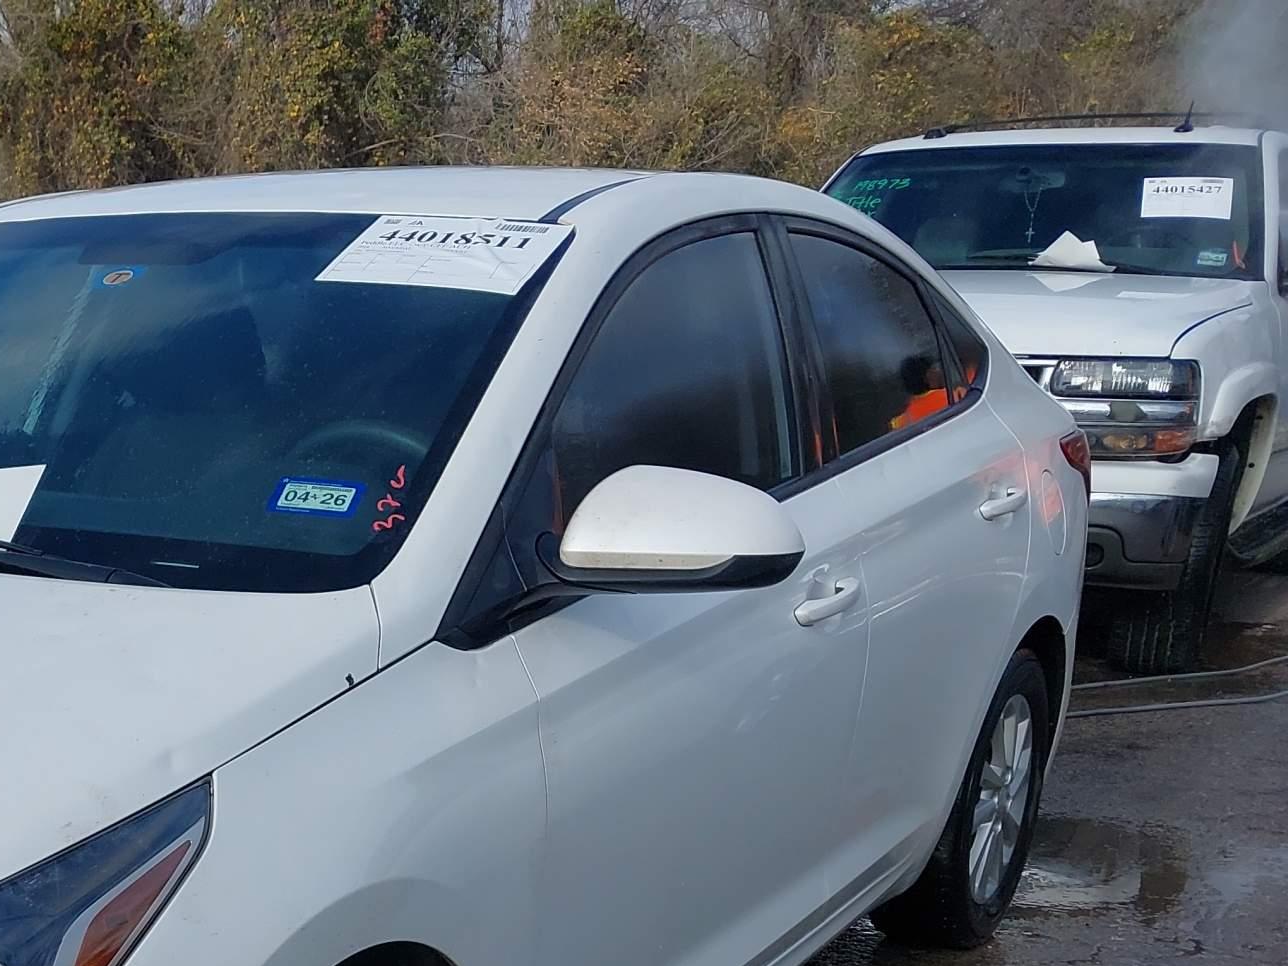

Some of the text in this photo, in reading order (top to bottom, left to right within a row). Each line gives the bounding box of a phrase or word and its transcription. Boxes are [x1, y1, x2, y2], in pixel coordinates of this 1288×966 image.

[1152, 185, 1223, 194] 44015427
[379, 229, 532, 250] 44018511
[319, 493, 348, 506] 26
